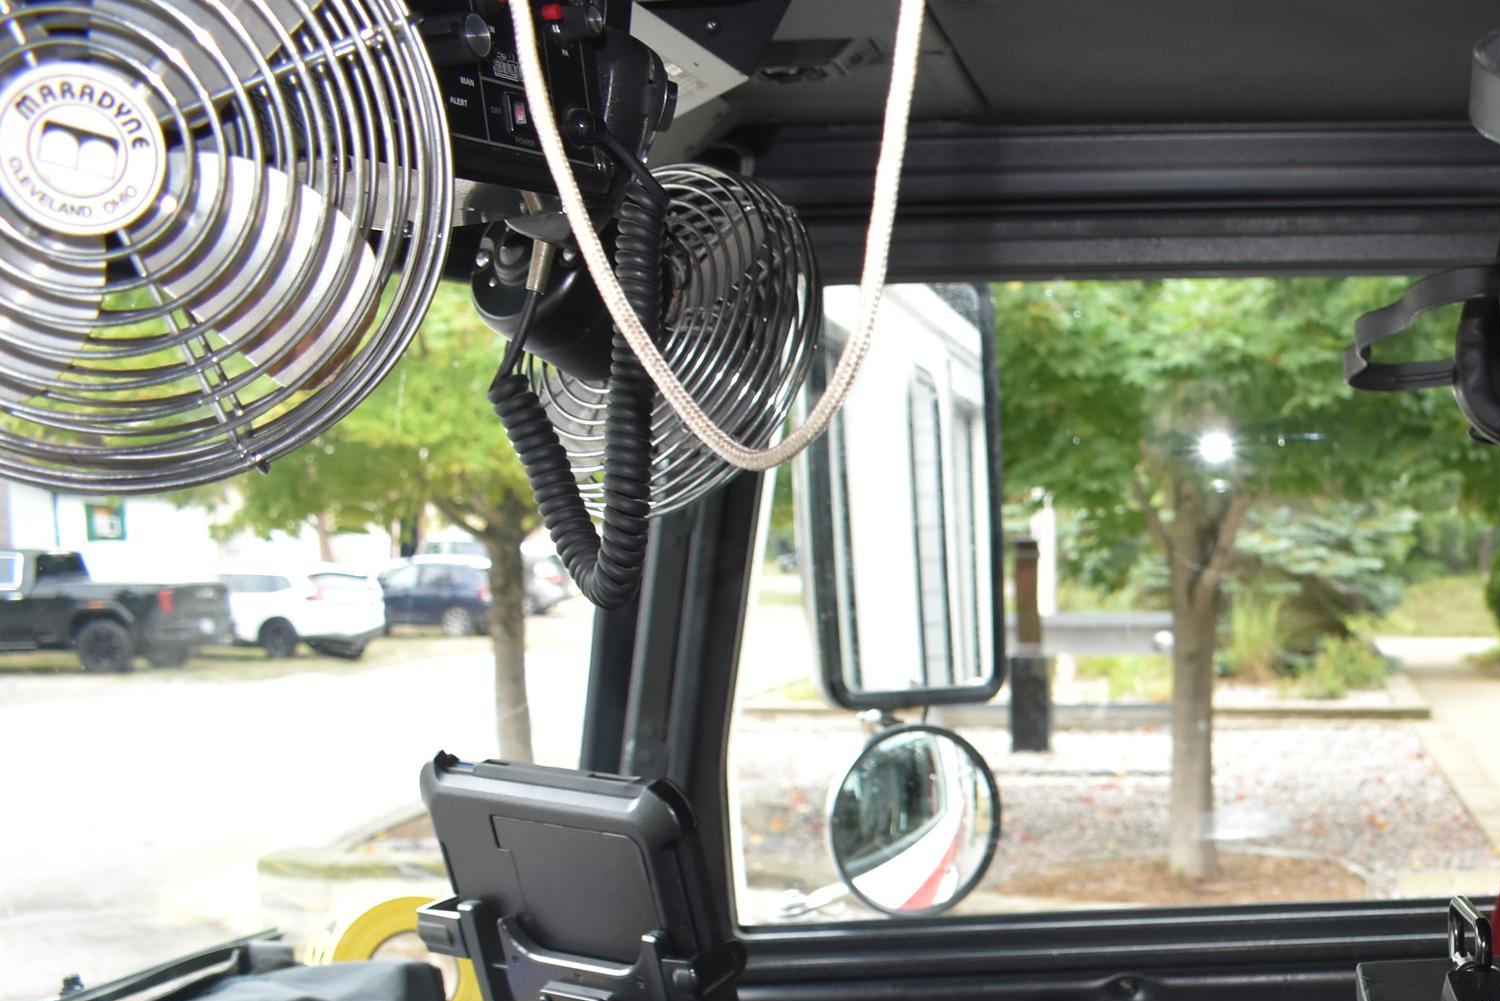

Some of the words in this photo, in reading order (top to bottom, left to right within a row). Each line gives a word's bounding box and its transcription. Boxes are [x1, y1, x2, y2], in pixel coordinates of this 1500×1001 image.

[14, 80, 151, 150] MARADYNE
[449, 96, 469, 107] ALERT
[8, 156, 93, 218] CLEVELAND
[103, 185, 138, 214] OHIO
